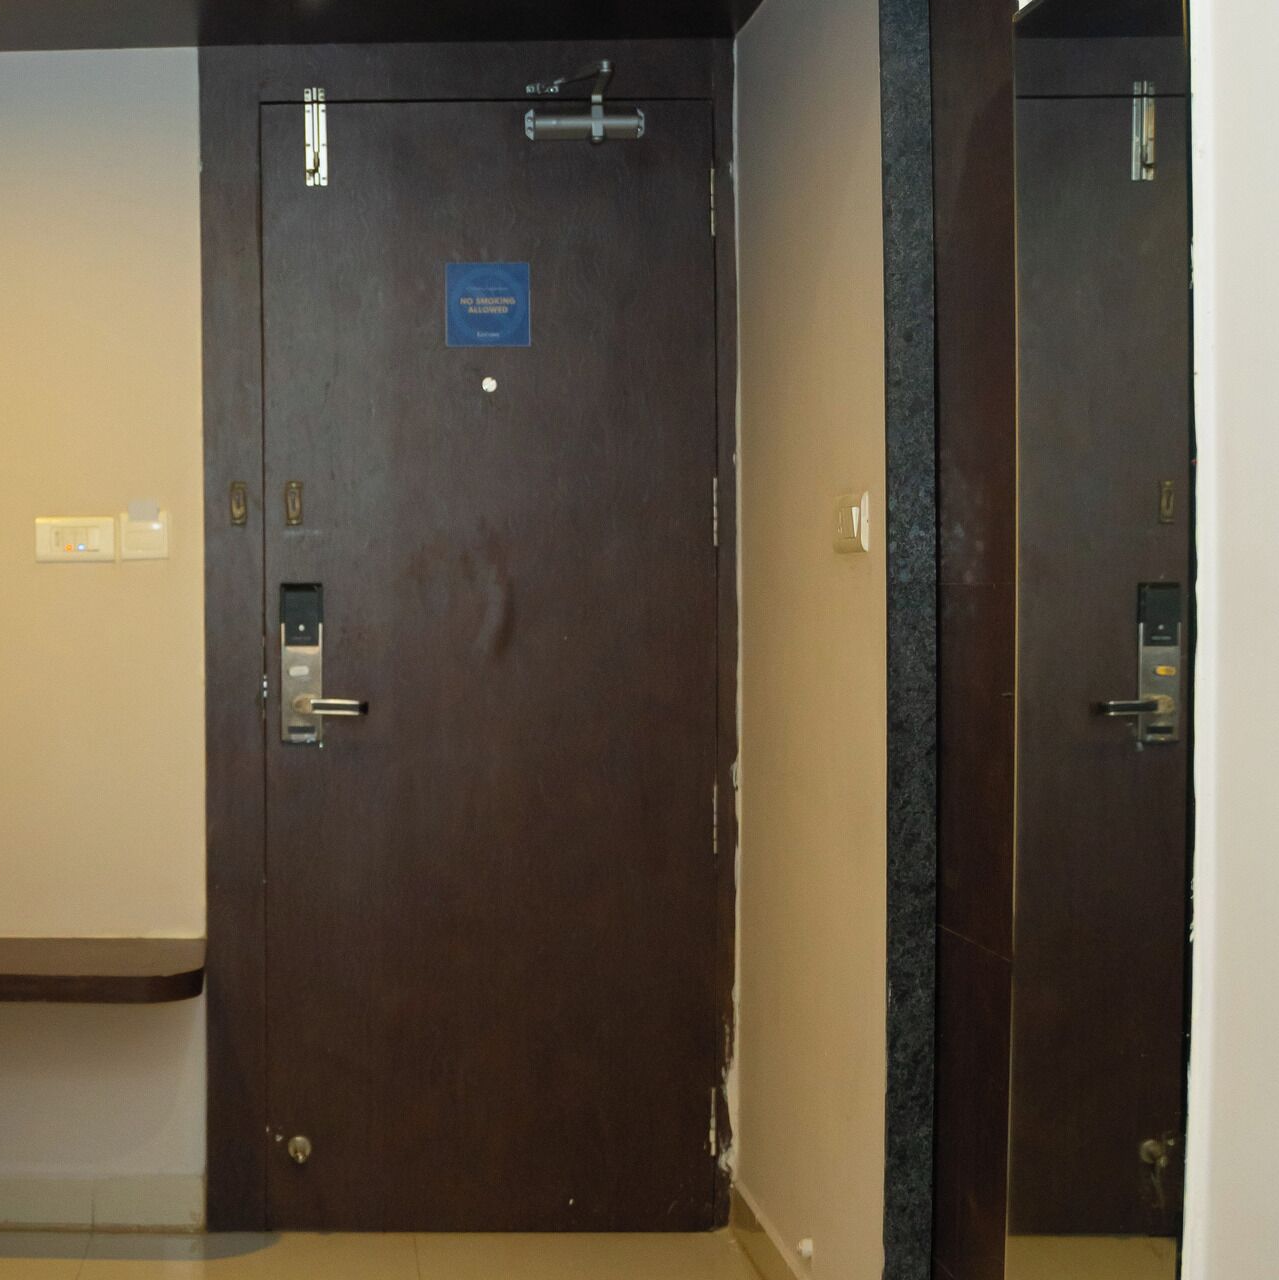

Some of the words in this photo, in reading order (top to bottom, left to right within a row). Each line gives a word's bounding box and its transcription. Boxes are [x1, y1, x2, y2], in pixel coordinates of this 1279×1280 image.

[460, 297, 473, 305] NO
[475, 297, 516, 305] SMOKING
[468, 306, 508, 314] ALLOWED
